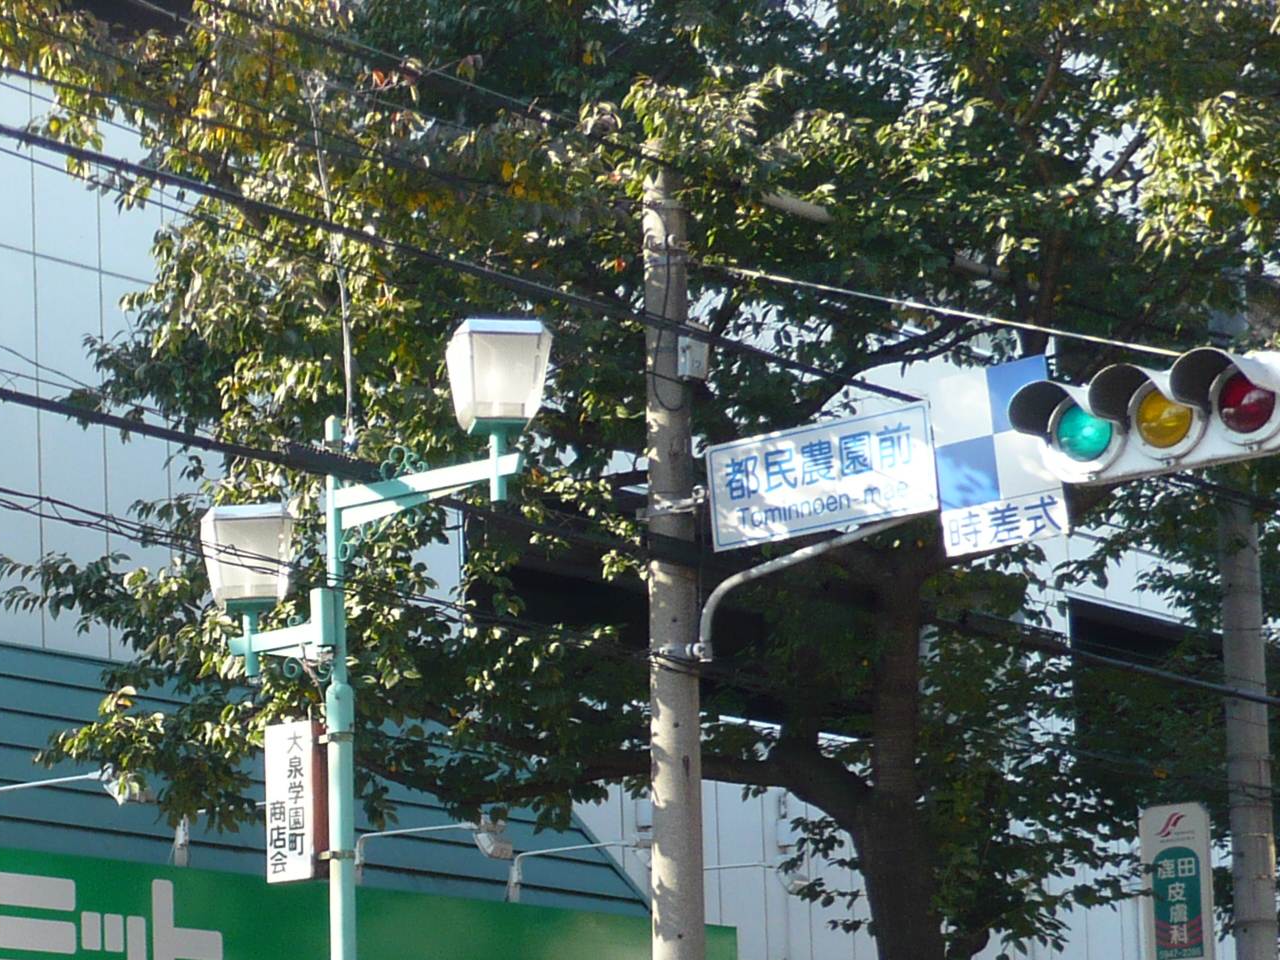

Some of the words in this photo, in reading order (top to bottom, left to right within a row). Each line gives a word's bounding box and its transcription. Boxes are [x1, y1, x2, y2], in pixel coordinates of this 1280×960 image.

[725, 421, 912, 502] 都民農園前
[736, 480, 909, 529] Tominnoen-mae
[949, 498, 1062, 550] 時差式
[287, 731, 305, 856] 大泉学園町
[269, 800, 288, 875] 商店会
